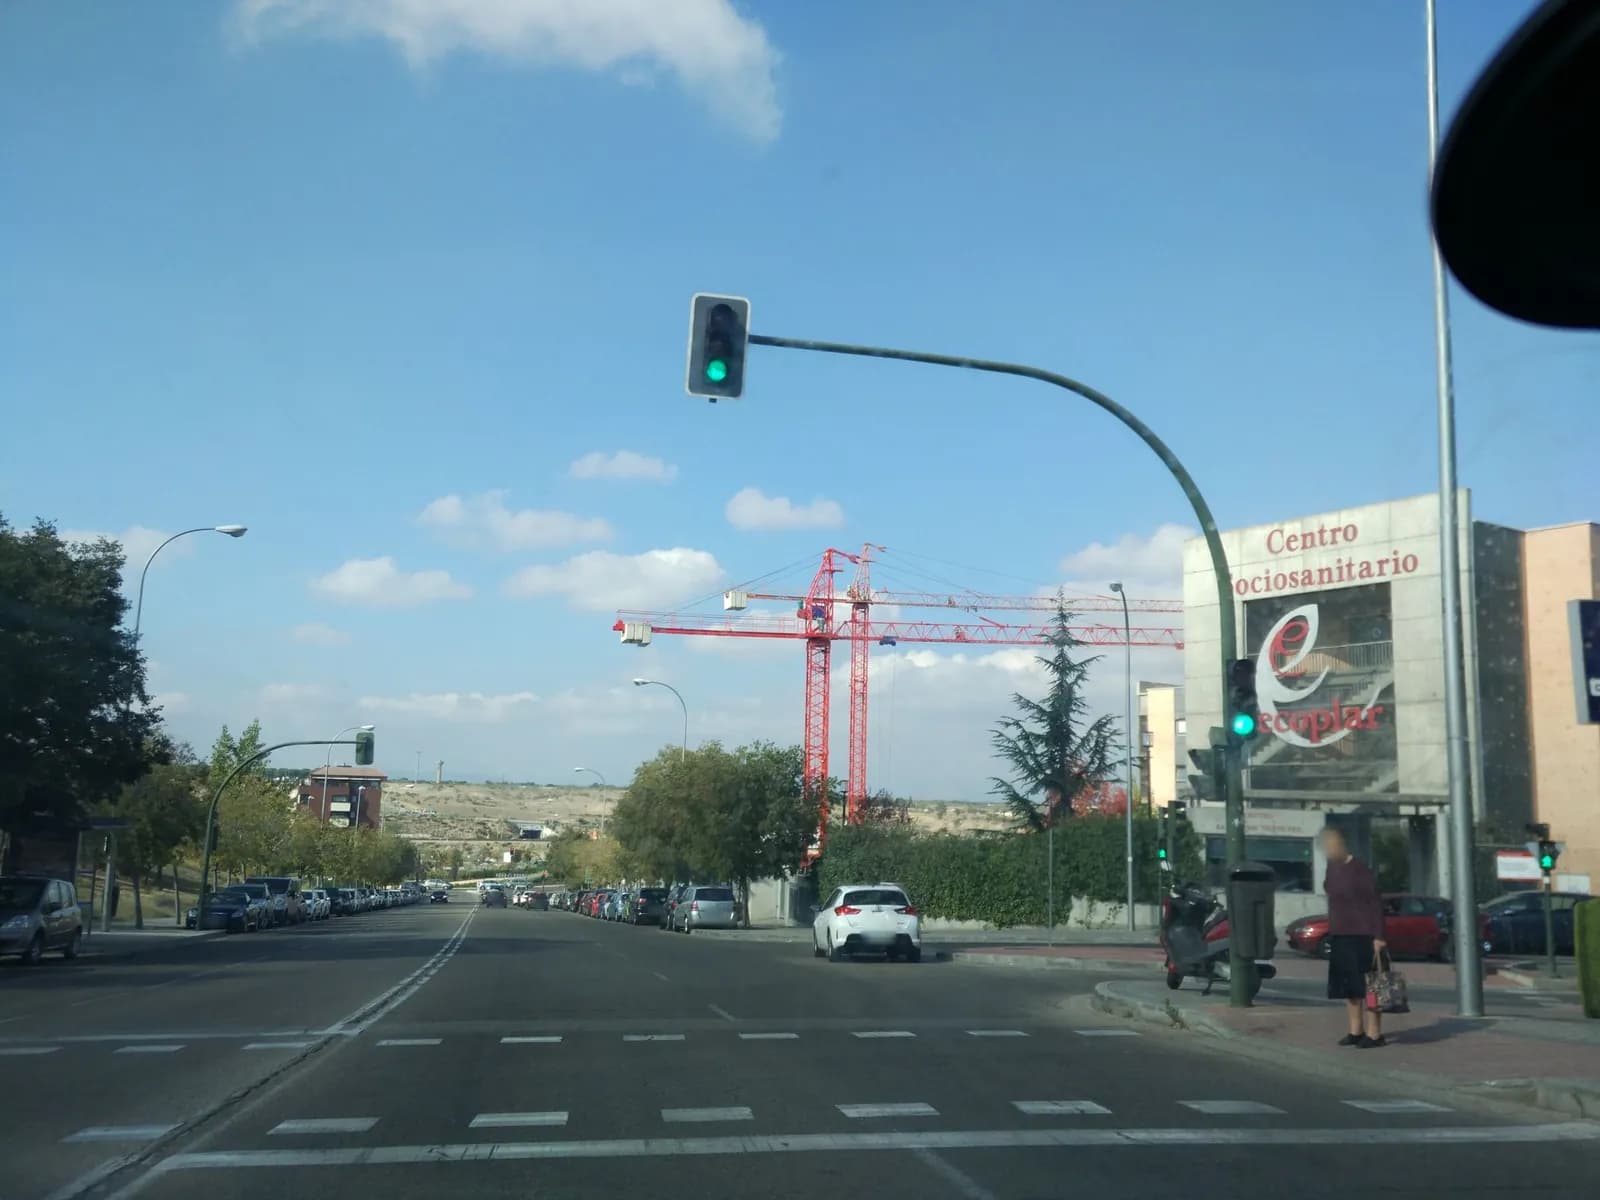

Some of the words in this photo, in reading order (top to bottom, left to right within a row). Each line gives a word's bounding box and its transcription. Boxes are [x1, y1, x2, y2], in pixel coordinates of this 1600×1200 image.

[1267, 523, 1358, 554] Centro
[1230, 551, 1418, 595] ociosanitario
[1257, 698, 1385, 743] ecoplar
